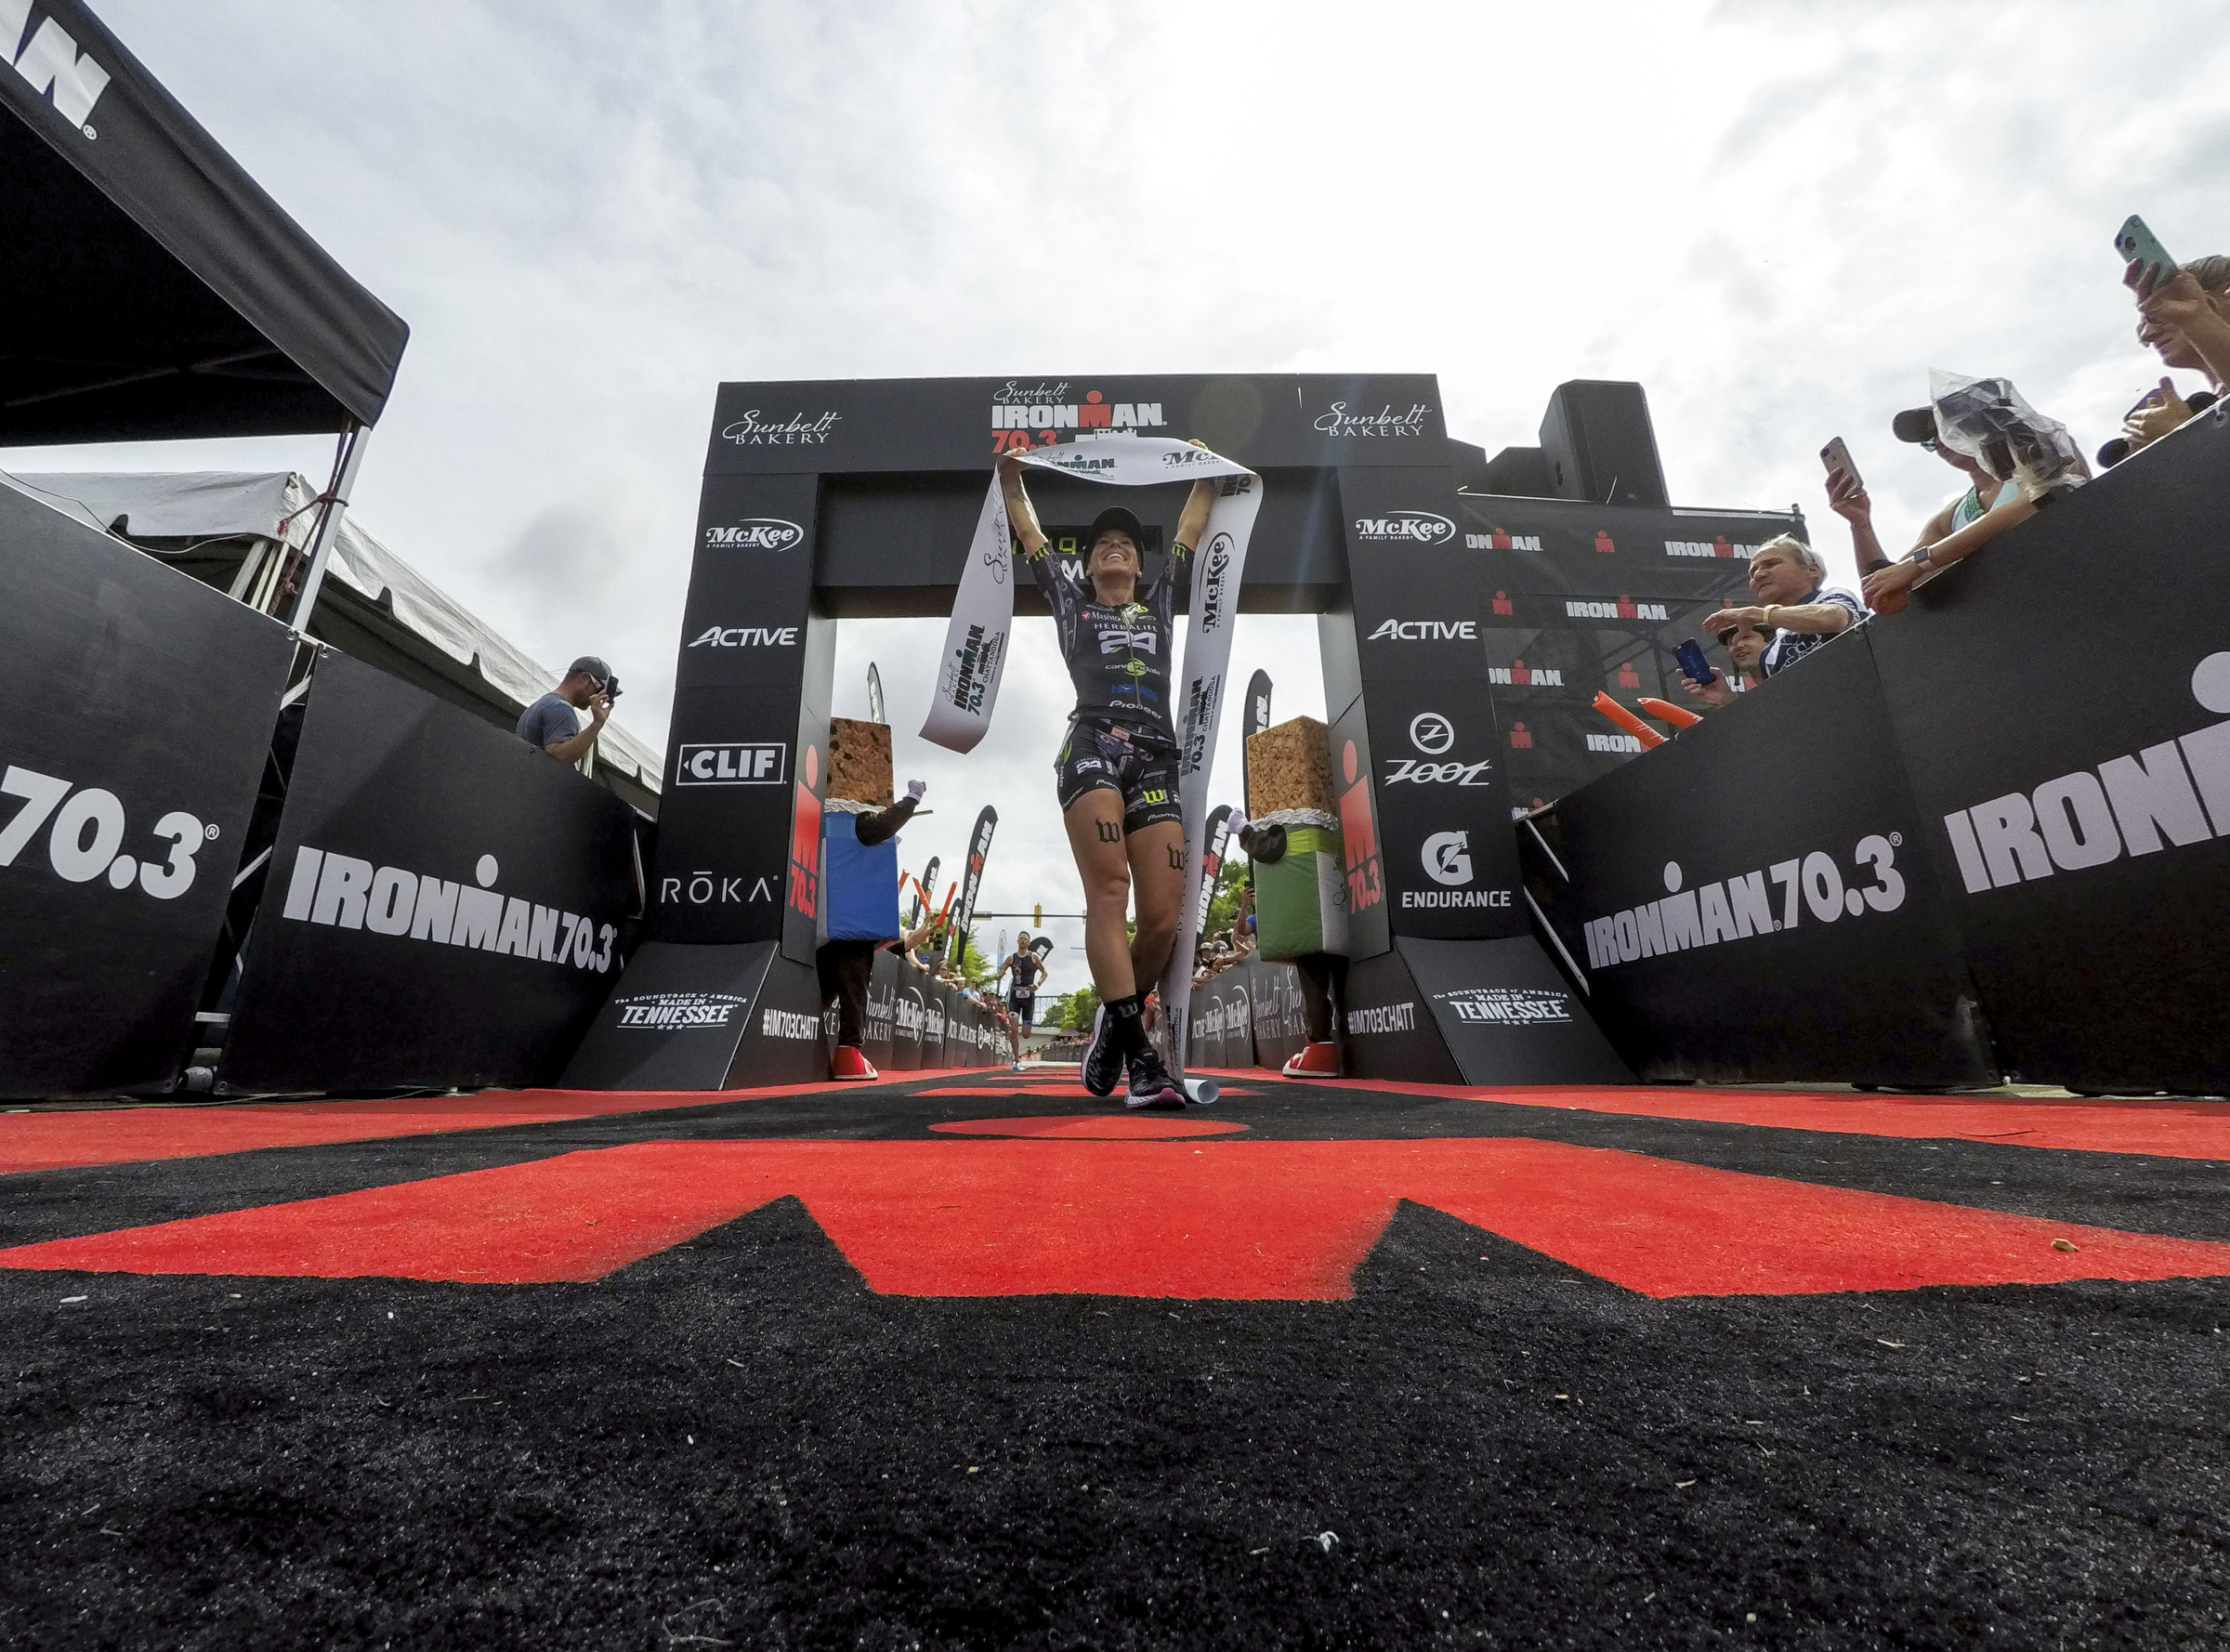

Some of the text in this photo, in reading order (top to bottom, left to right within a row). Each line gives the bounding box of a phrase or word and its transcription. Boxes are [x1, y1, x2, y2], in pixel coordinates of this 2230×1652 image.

[993, 381, 1071, 400] Sunbelt
[991, 390, 1162, 429] IRONMAN
[1314, 401, 1432, 431] Sunbelt
[722, 409, 842, 440] Sunbelt
[1329, 426, 1424, 438] BAKERY
[735, 433, 830, 445] BAKERY
[706, 527, 794, 549] McKee
[1355, 518, 1447, 542] McKee
[1566, 595, 1670, 621] IRONMAN
[688, 626, 798, 648] ACTIVE
[1367, 619, 1477, 639] ACTIVE
[953, 624, 985, 711] IRONMAN
[967, 681, 986, 716] 70.3
[1586, 734, 1647, 754] IRON
[690, 750, 776, 779] CLIF
[282, 846, 559, 963] IRONMAN
[1401, 891, 1512, 908] ENDURANCE
[1584, 861, 1775, 969] IRONMAN
[710, 994, 747, 1003] AMERICA
[1522, 990, 1569, 999] AMERICA
[621, 1004, 734, 1024] TENNESSEE
[1449, 1000, 1570, 1019] TENNESSEE
